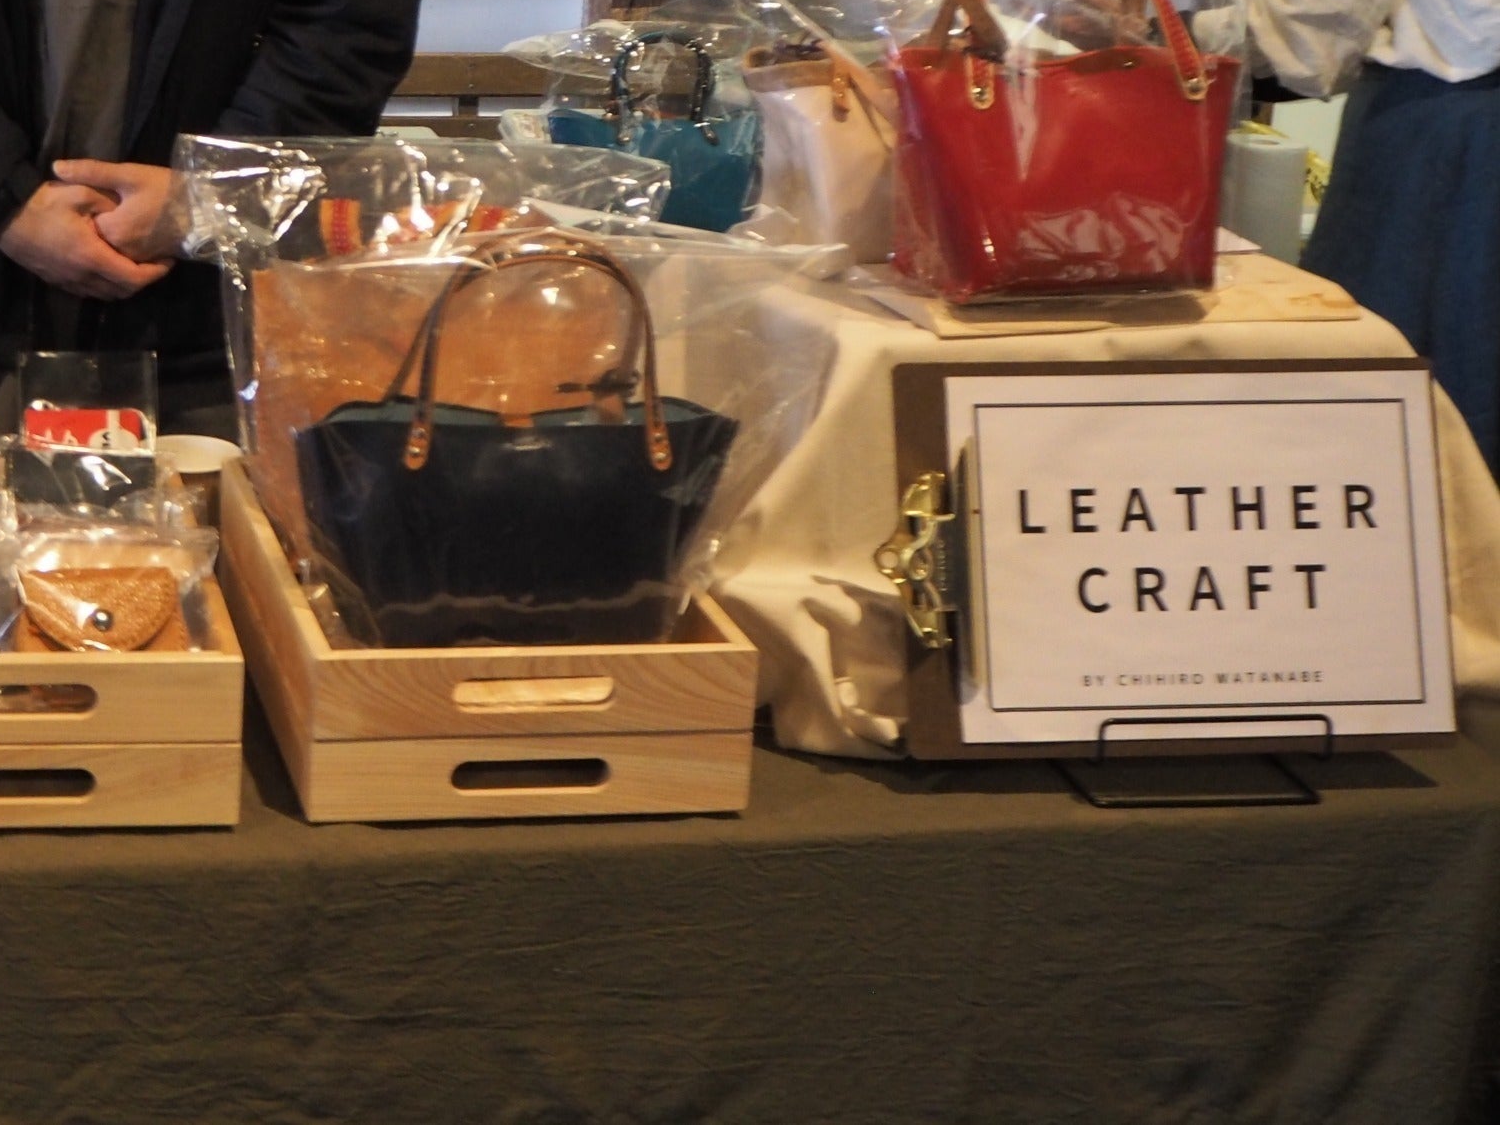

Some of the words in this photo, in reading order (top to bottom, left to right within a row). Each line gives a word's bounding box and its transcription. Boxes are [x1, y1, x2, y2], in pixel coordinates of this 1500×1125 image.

[1016, 484, 1379, 535] LEATHER
[1076, 563, 1328, 615] CRAFT
[1081, 674, 1106, 688] BY
[1118, 672, 1205, 688] CHIHIRO
[1215, 670, 1325, 686] WATANABE
